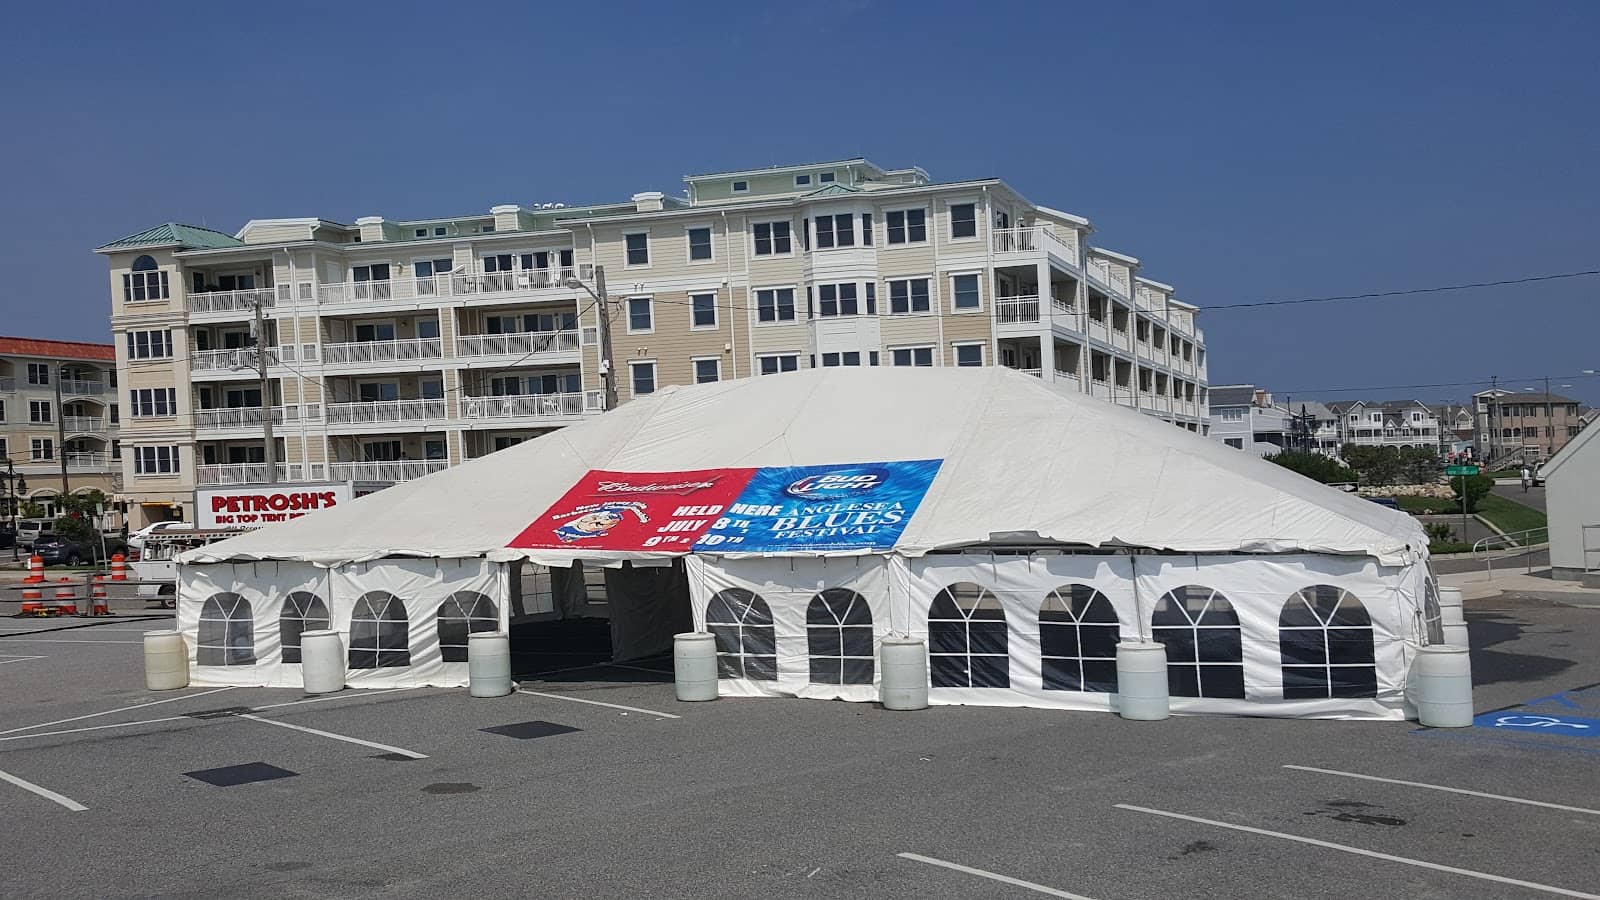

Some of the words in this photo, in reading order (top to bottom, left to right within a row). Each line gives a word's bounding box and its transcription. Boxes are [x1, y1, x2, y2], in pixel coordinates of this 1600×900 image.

[597, 480, 714, 493] Budweiser
[799, 481, 882, 490] LIGHT
[211, 491, 337, 512] PETROSH'S
[672, 505, 724, 517] HELD
[729, 504, 783, 517] HERE
[786, 502, 904, 518] ANGLESEA
[215, 514, 235, 524] BIG
[237, 513, 259, 523] TOP
[260, 512, 287, 522] TENT
[768, 511, 907, 532] BLUES
[657, 520, 708, 533] JULY
[774, 525, 880, 539] FESTIVAL
